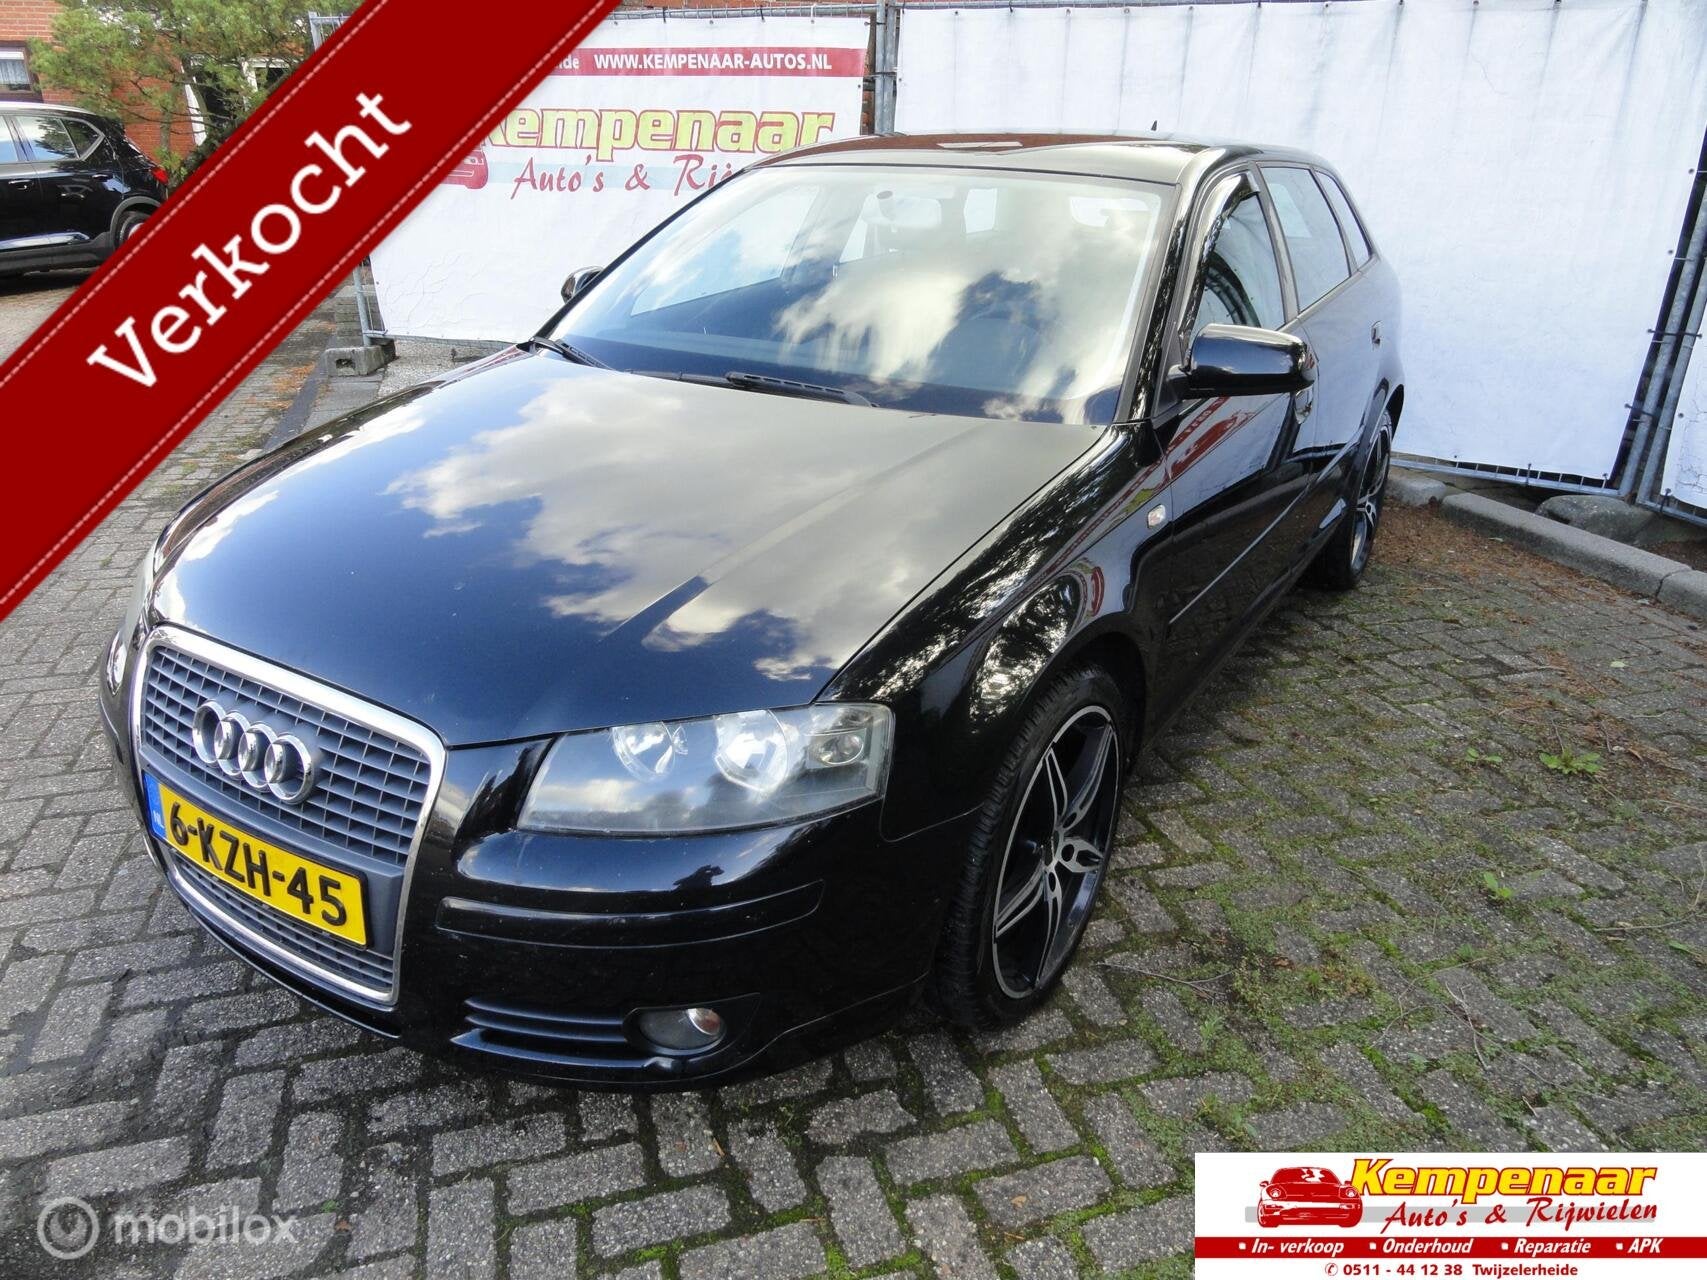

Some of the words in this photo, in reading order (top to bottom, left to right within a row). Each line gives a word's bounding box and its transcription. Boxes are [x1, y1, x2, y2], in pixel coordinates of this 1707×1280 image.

[593, 53, 833, 70] WWW.KEMPENAAR-AUTOS.NL
[510, 154, 604, 200] Auto's
[624, 163, 651, 191] &
[170, 801, 347, 927] 6-KZH-45
